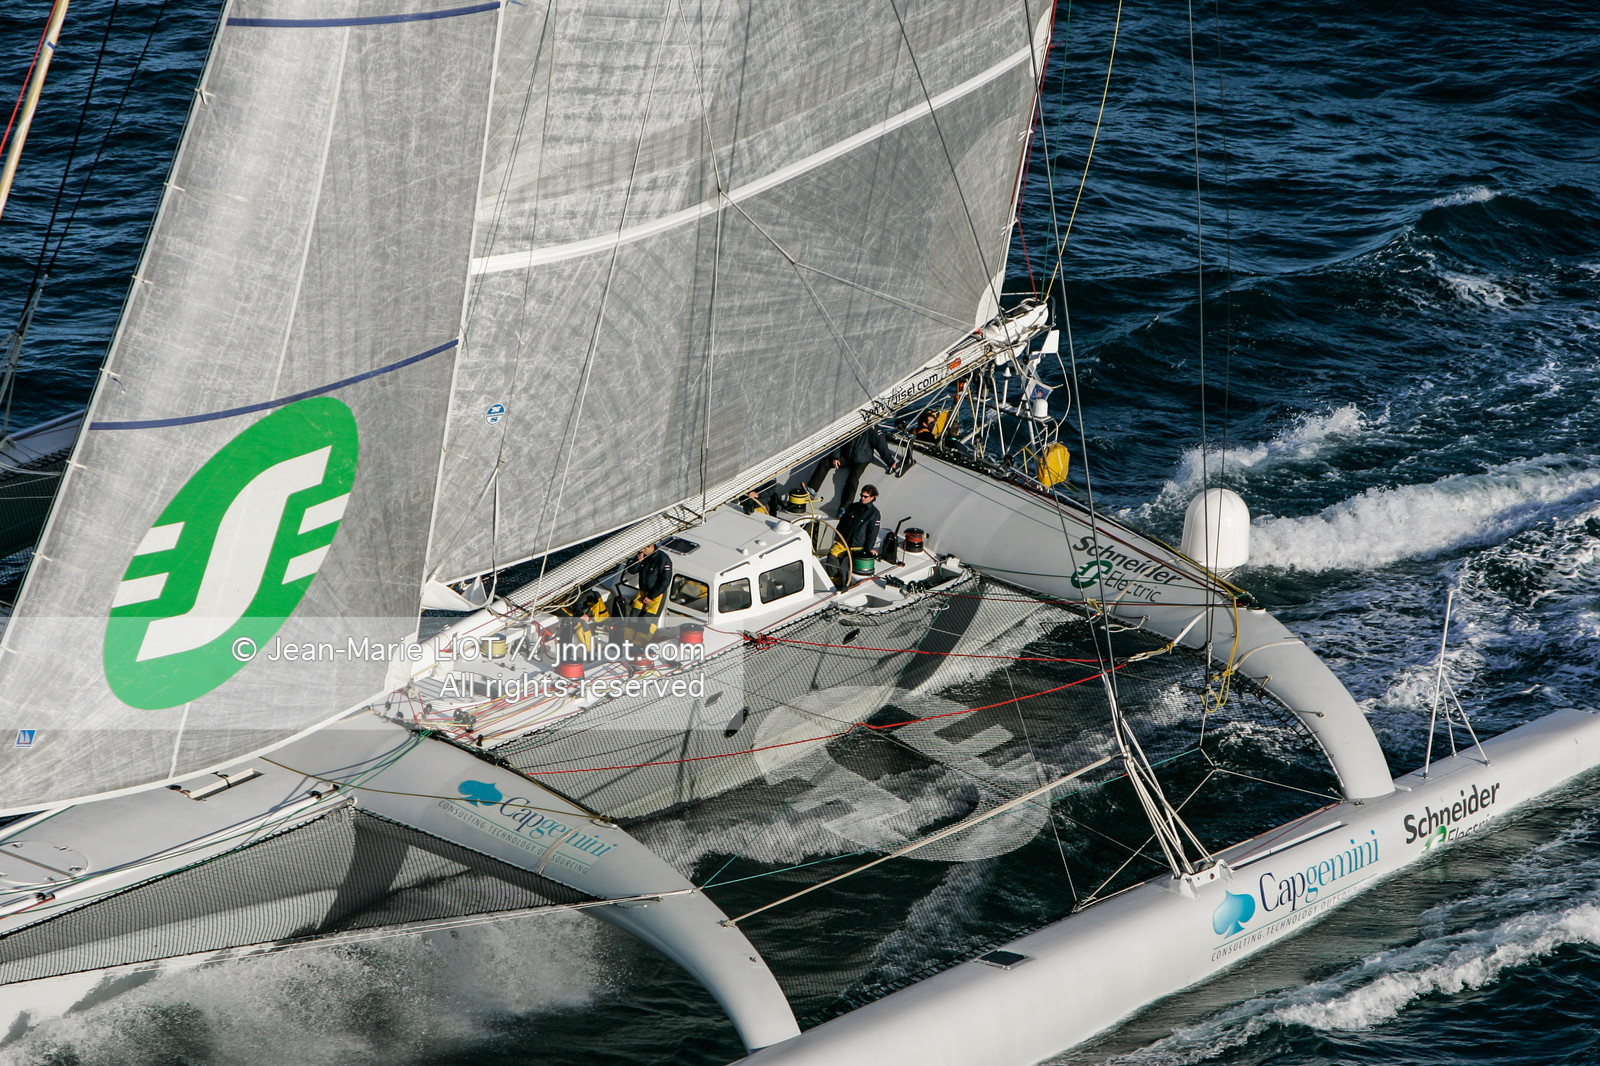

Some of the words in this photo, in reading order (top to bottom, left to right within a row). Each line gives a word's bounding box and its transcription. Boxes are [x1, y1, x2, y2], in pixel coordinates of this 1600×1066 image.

[1072, 536, 1182, 585] Schneider
[1403, 782, 1500, 845] Schneider
[1259, 829, 1380, 913] Capgemini
